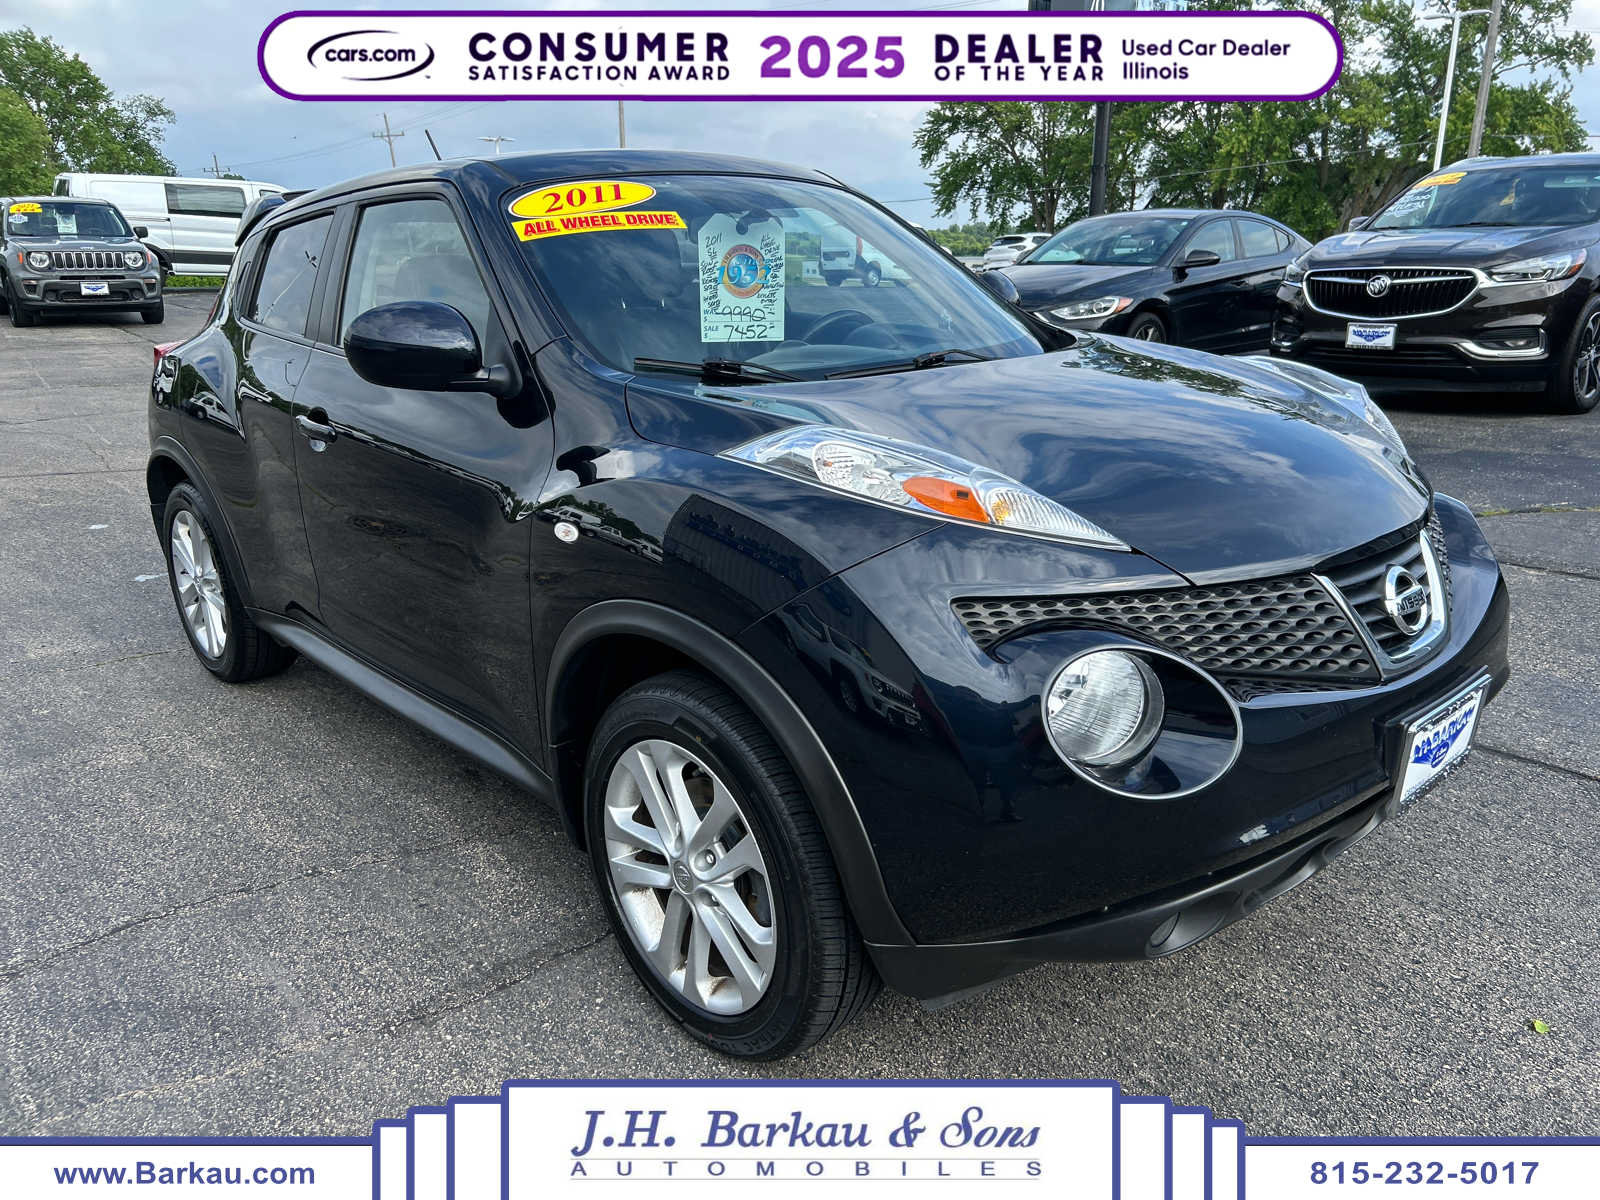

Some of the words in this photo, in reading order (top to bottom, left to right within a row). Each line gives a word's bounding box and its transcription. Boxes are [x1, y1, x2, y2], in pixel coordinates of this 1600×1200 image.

[542, 184, 627, 213] 2011
[523, 221, 560, 237] ALL
[560, 215, 625, 230] WHEEL
[626, 213, 680, 226] DRIVE
[724, 324, 768, 342] 7452
